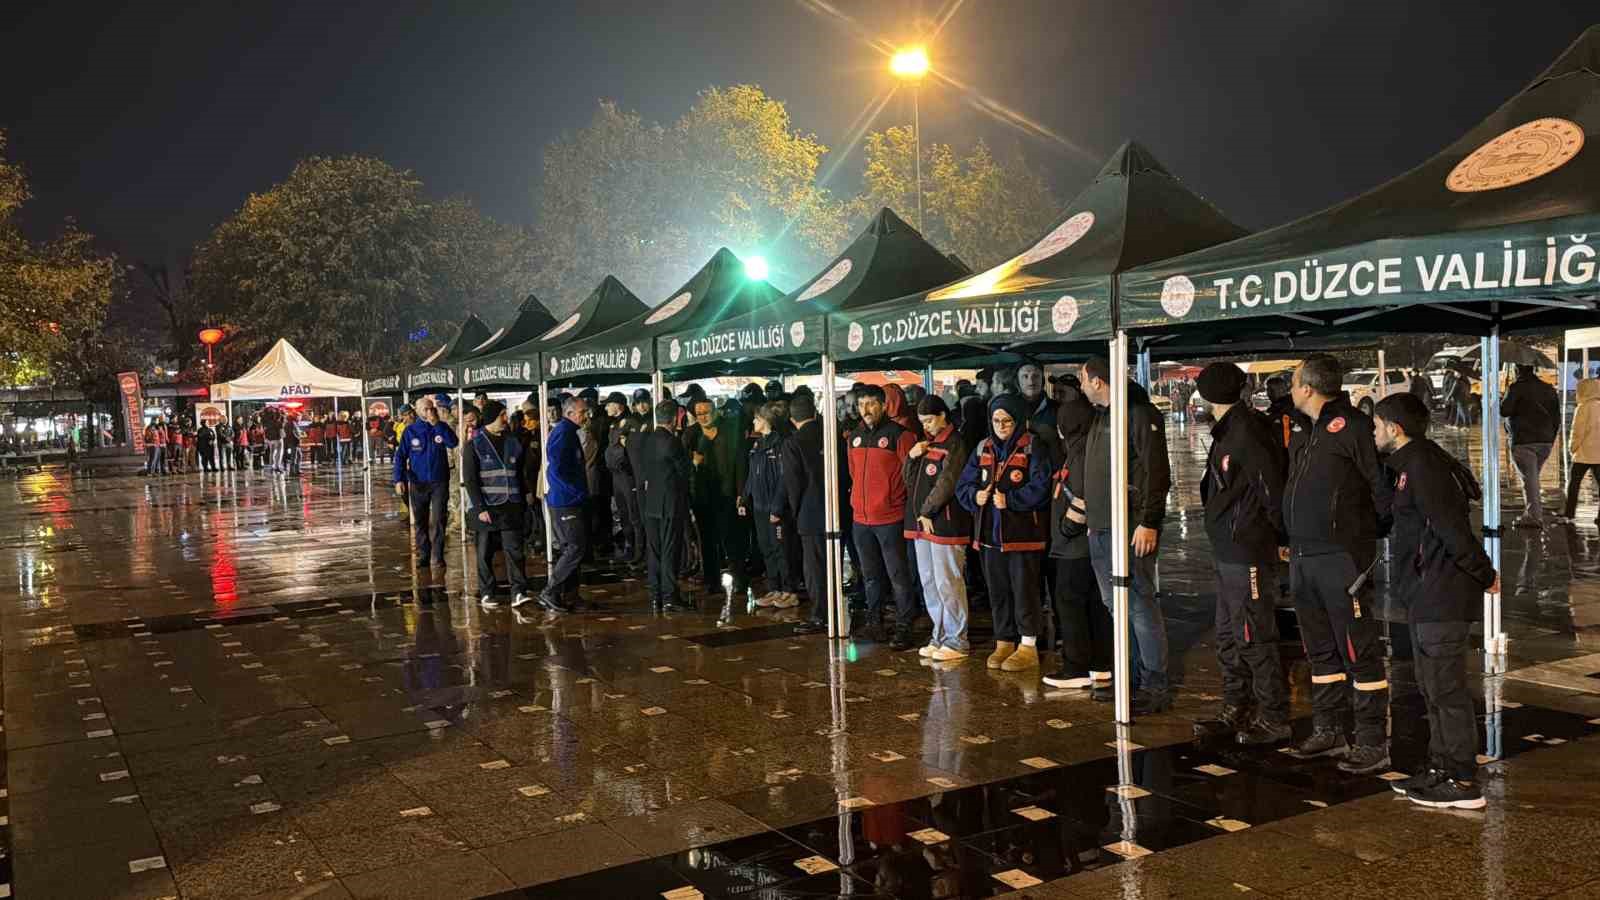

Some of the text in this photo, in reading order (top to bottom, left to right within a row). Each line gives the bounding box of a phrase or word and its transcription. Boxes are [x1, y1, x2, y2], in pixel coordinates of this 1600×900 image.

[1415, 233, 1600, 292] VALİLİĞ
[956, 300, 1041, 334] VALİLİĞİ
[737, 324, 785, 350] VALİLİĞİ
[280, 384, 312, 395] AFAD
